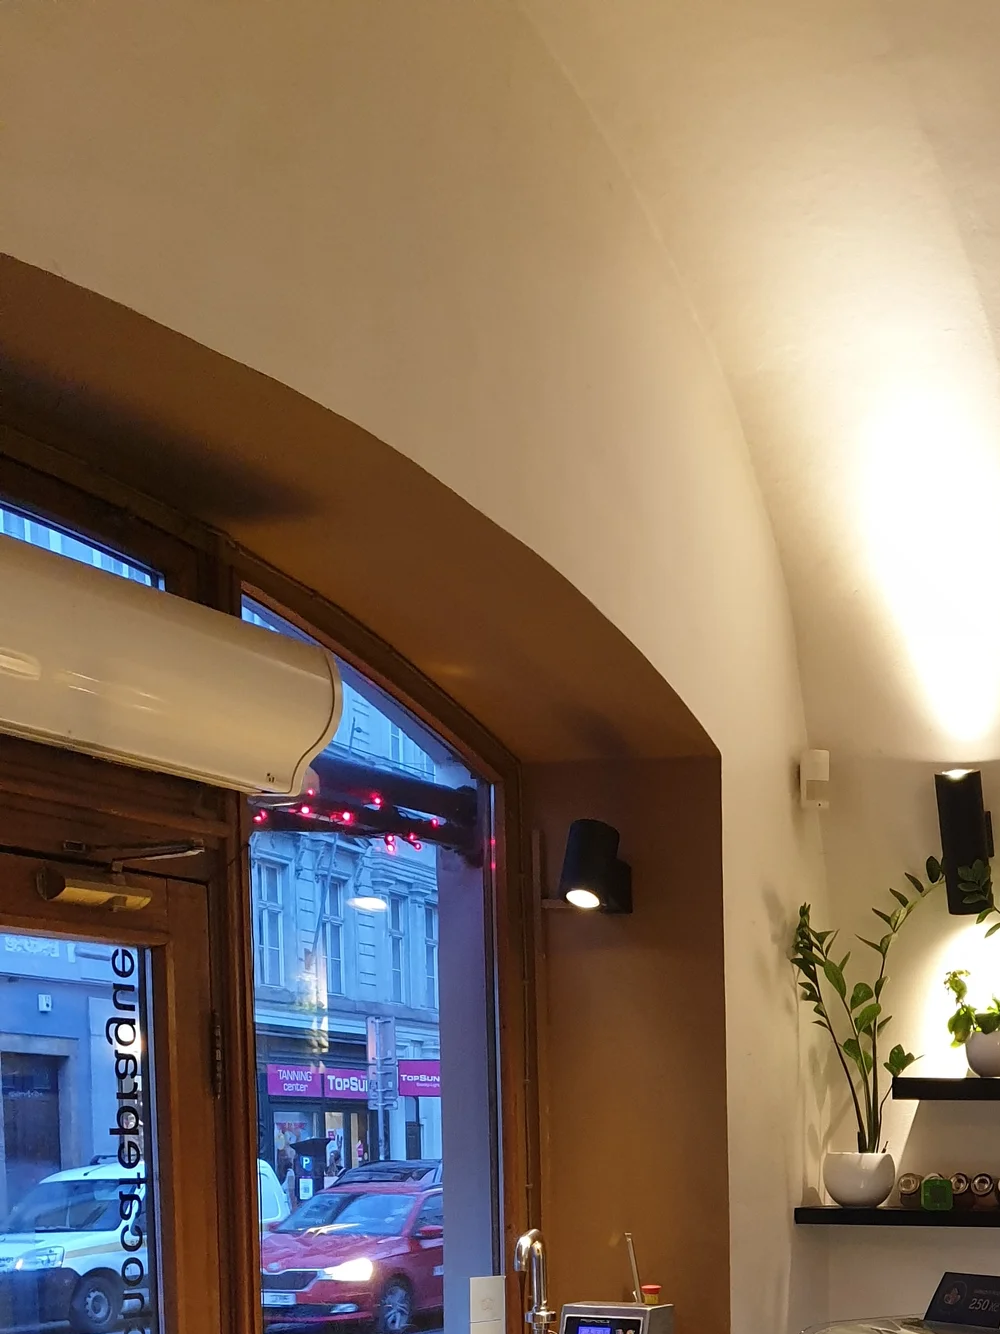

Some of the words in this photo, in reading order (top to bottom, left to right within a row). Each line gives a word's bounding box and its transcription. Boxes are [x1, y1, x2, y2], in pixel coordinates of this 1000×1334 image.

[278, 1069, 312, 1081] TANNING
[283, 1083, 308, 1092] center
[302, 1157, 310, 1169] P
[968, 1298, 990, 1311] 250
